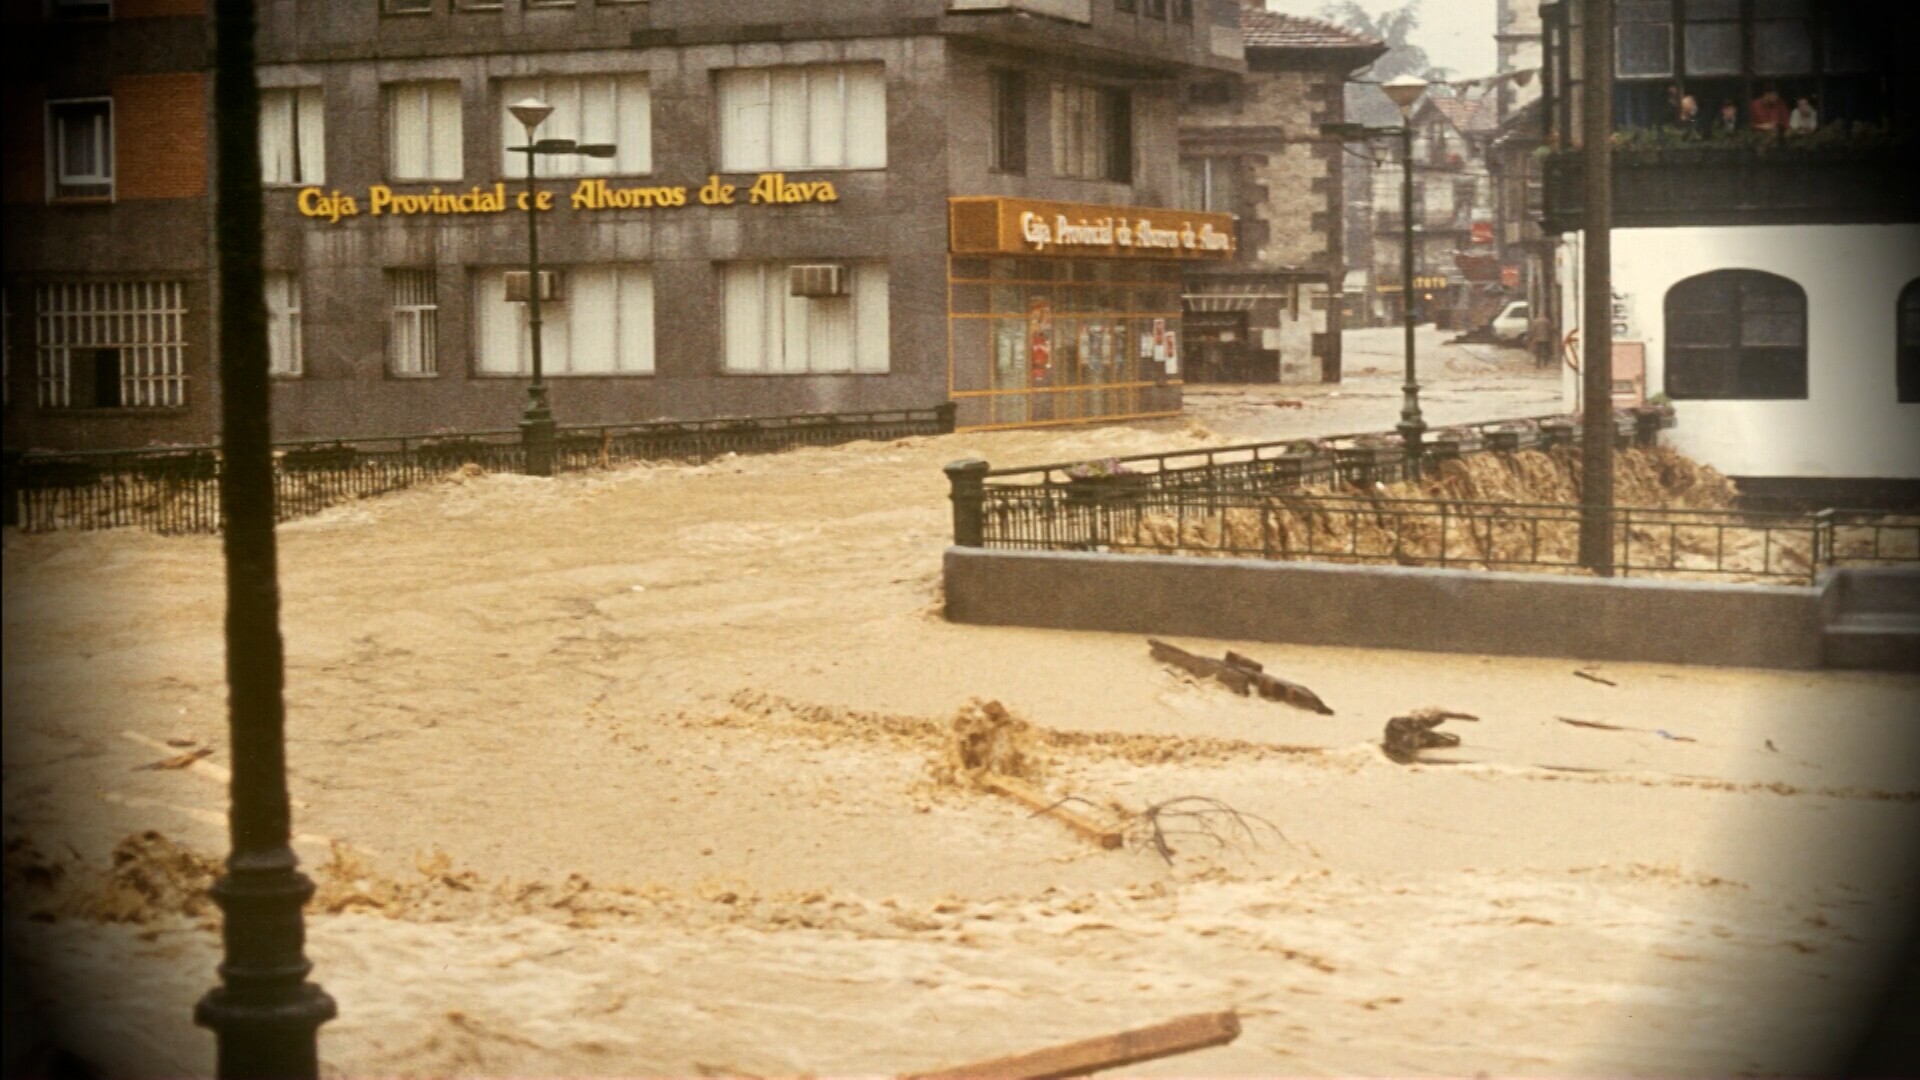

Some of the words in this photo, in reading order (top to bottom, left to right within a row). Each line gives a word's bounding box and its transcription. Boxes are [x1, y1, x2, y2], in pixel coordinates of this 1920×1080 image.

[298, 187, 358, 223] Caja
[369, 182, 505, 215] Provincial
[571, 179, 687, 209] Ahorros
[699, 175, 736, 205] de
[750, 172, 838, 204] Alava
[1020, 211, 1052, 250] Caja
[1055, 214, 1113, 245] Provincial
